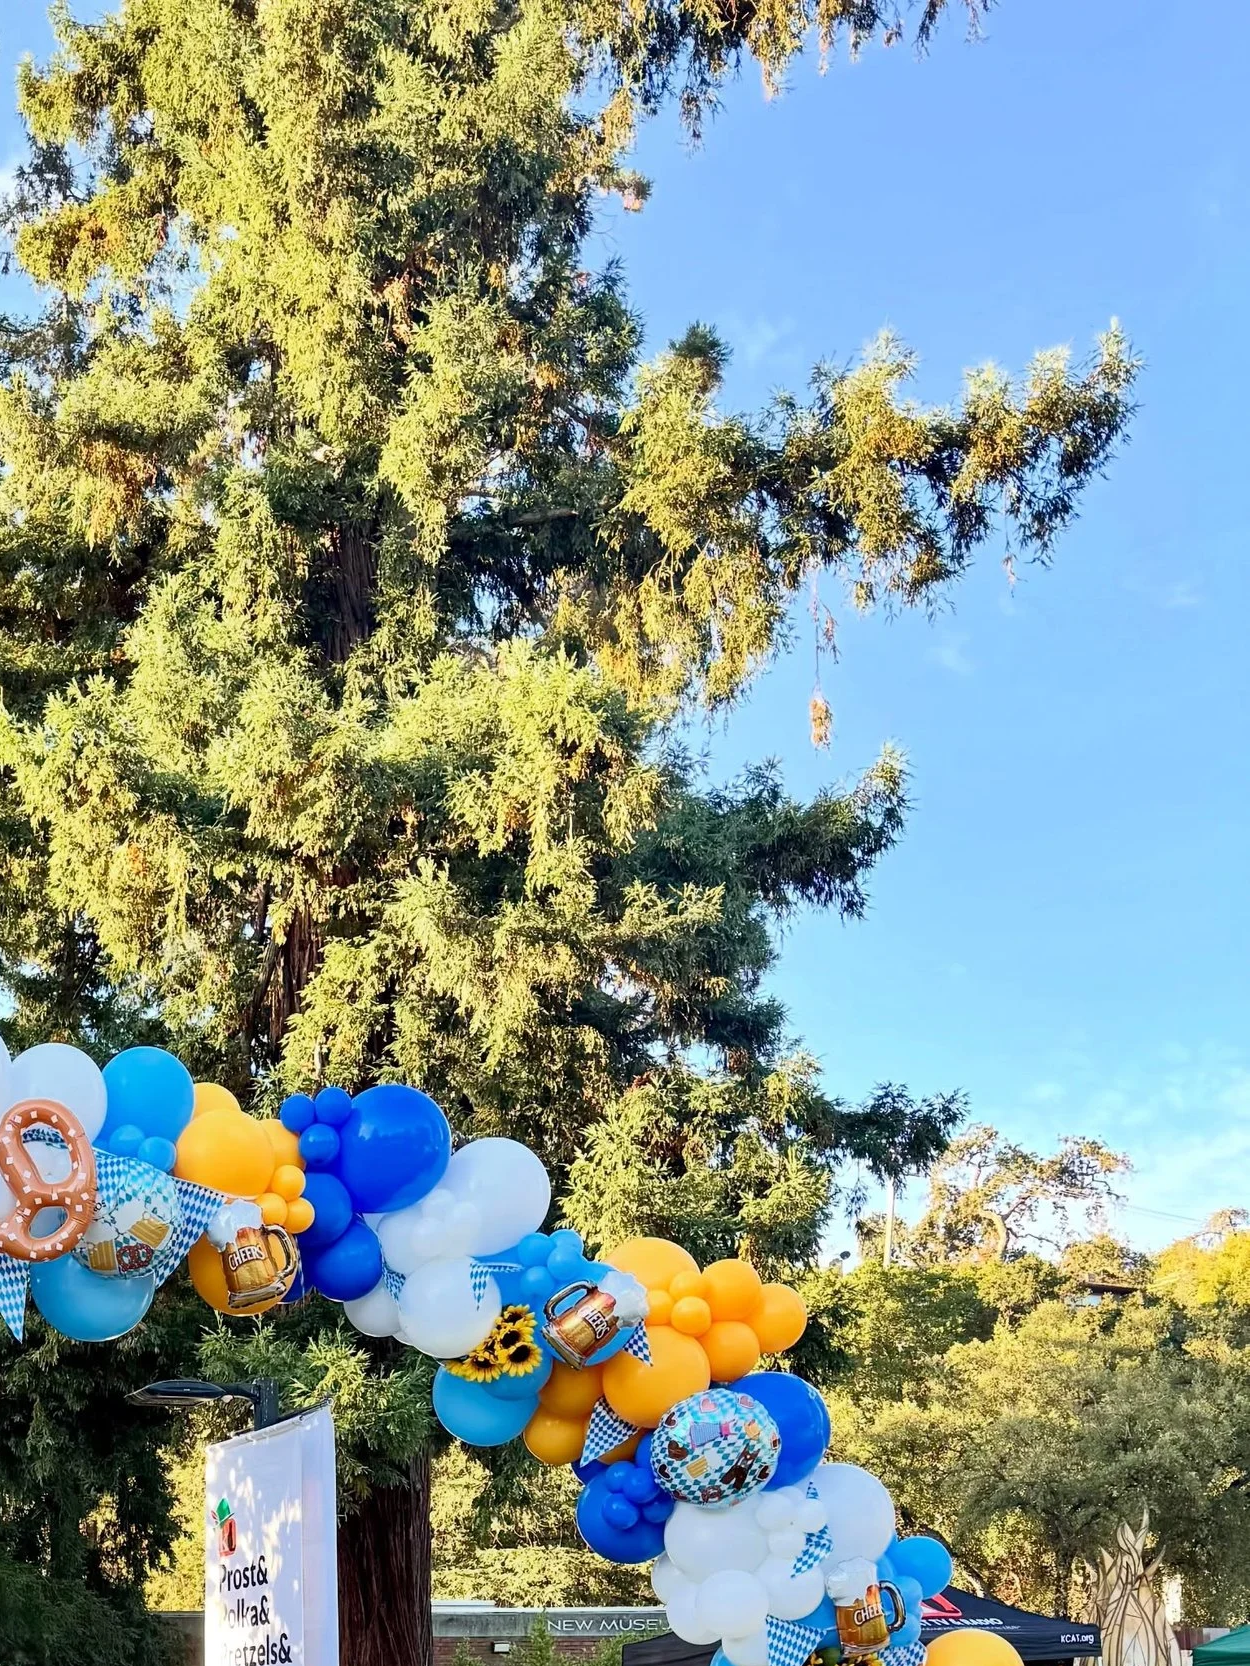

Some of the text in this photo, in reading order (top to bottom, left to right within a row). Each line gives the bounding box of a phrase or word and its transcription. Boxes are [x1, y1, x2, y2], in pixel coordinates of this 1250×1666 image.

[228, 1244, 267, 1271] CHEERS
[219, 1554, 269, 1593] Prost&
[547, 1619, 593, 1632] NEW
[1060, 1632, 1095, 1645] KCAT.org
